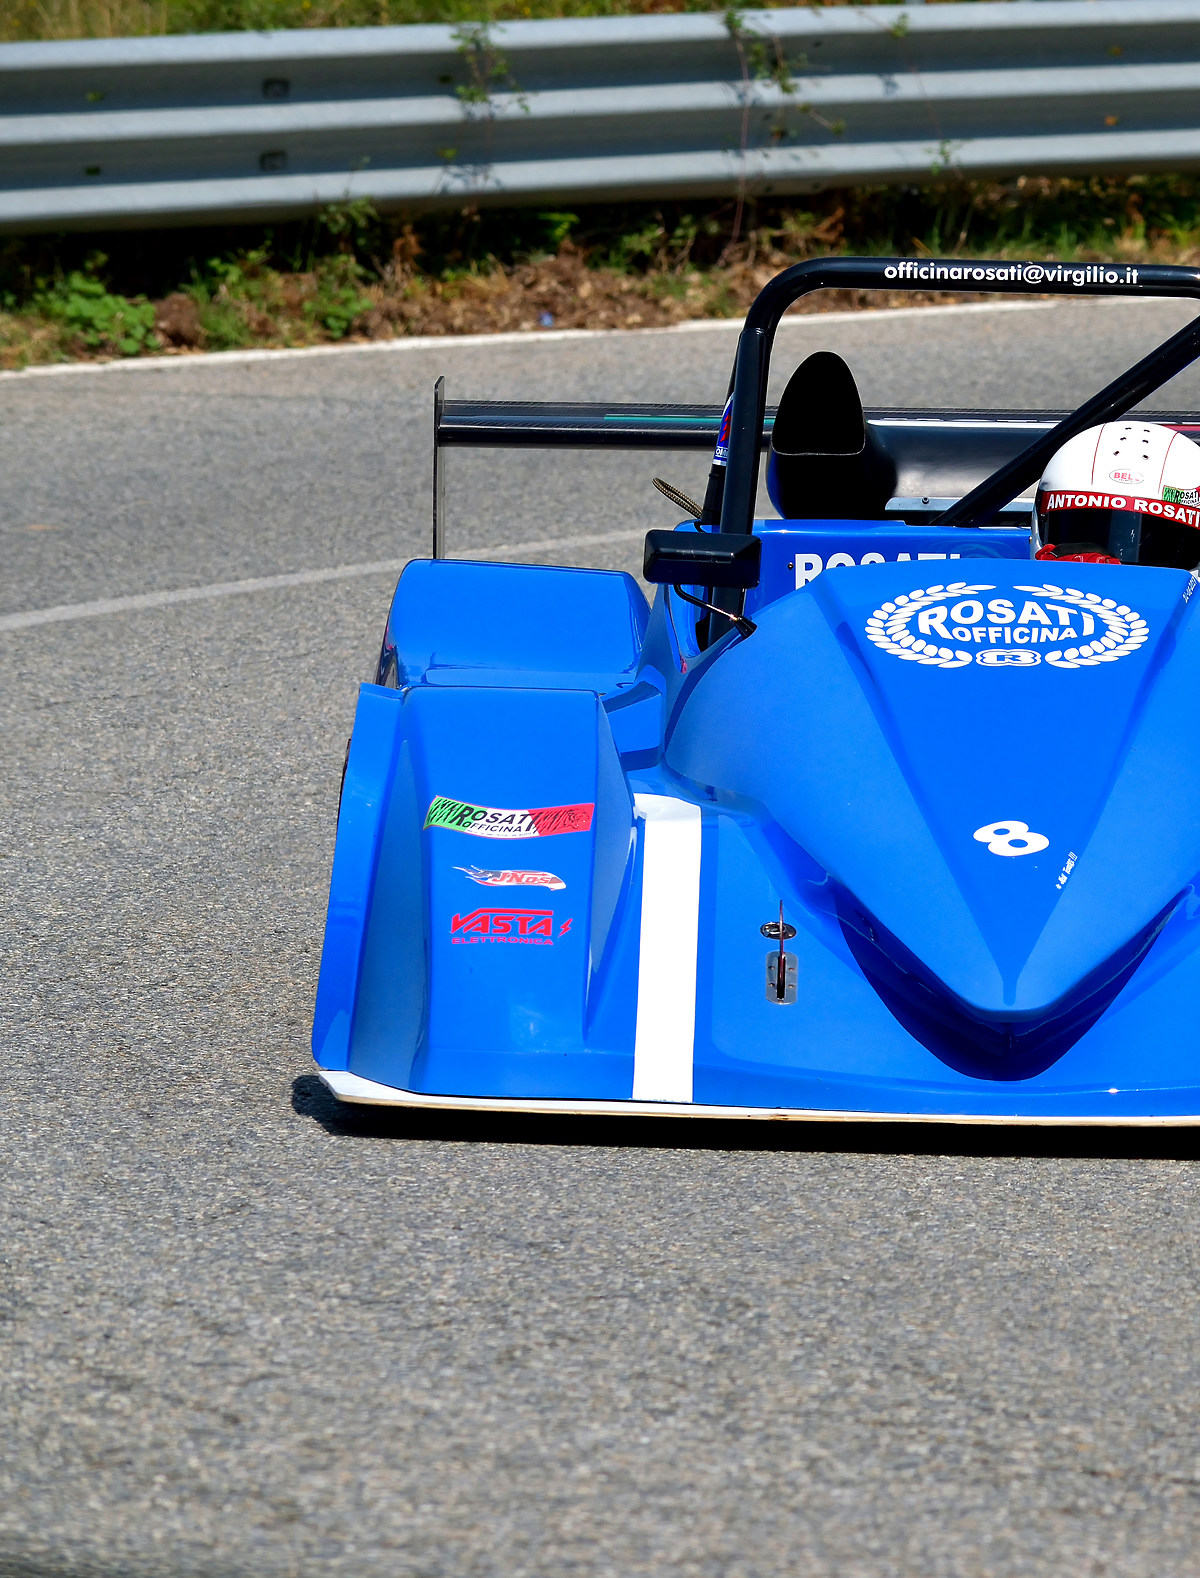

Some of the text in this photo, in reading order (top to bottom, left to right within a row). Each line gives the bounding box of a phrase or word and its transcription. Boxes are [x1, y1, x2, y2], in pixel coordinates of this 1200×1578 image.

[884, 262, 1139, 287] officinarosati@virgilio.it
[1047, 494, 1200, 528] ANTONIO ROSATI
[917, 599, 1095, 640] ROSATI
[953, 626, 1078, 644] OFFICINA
[450, 806, 540, 832] ROSATI
[463, 820, 522, 833] OFFICINA
[973, 820, 1050, 857] 8
[451, 908, 554, 937] VASTA
[452, 937, 554, 945] ELETTRONICA
